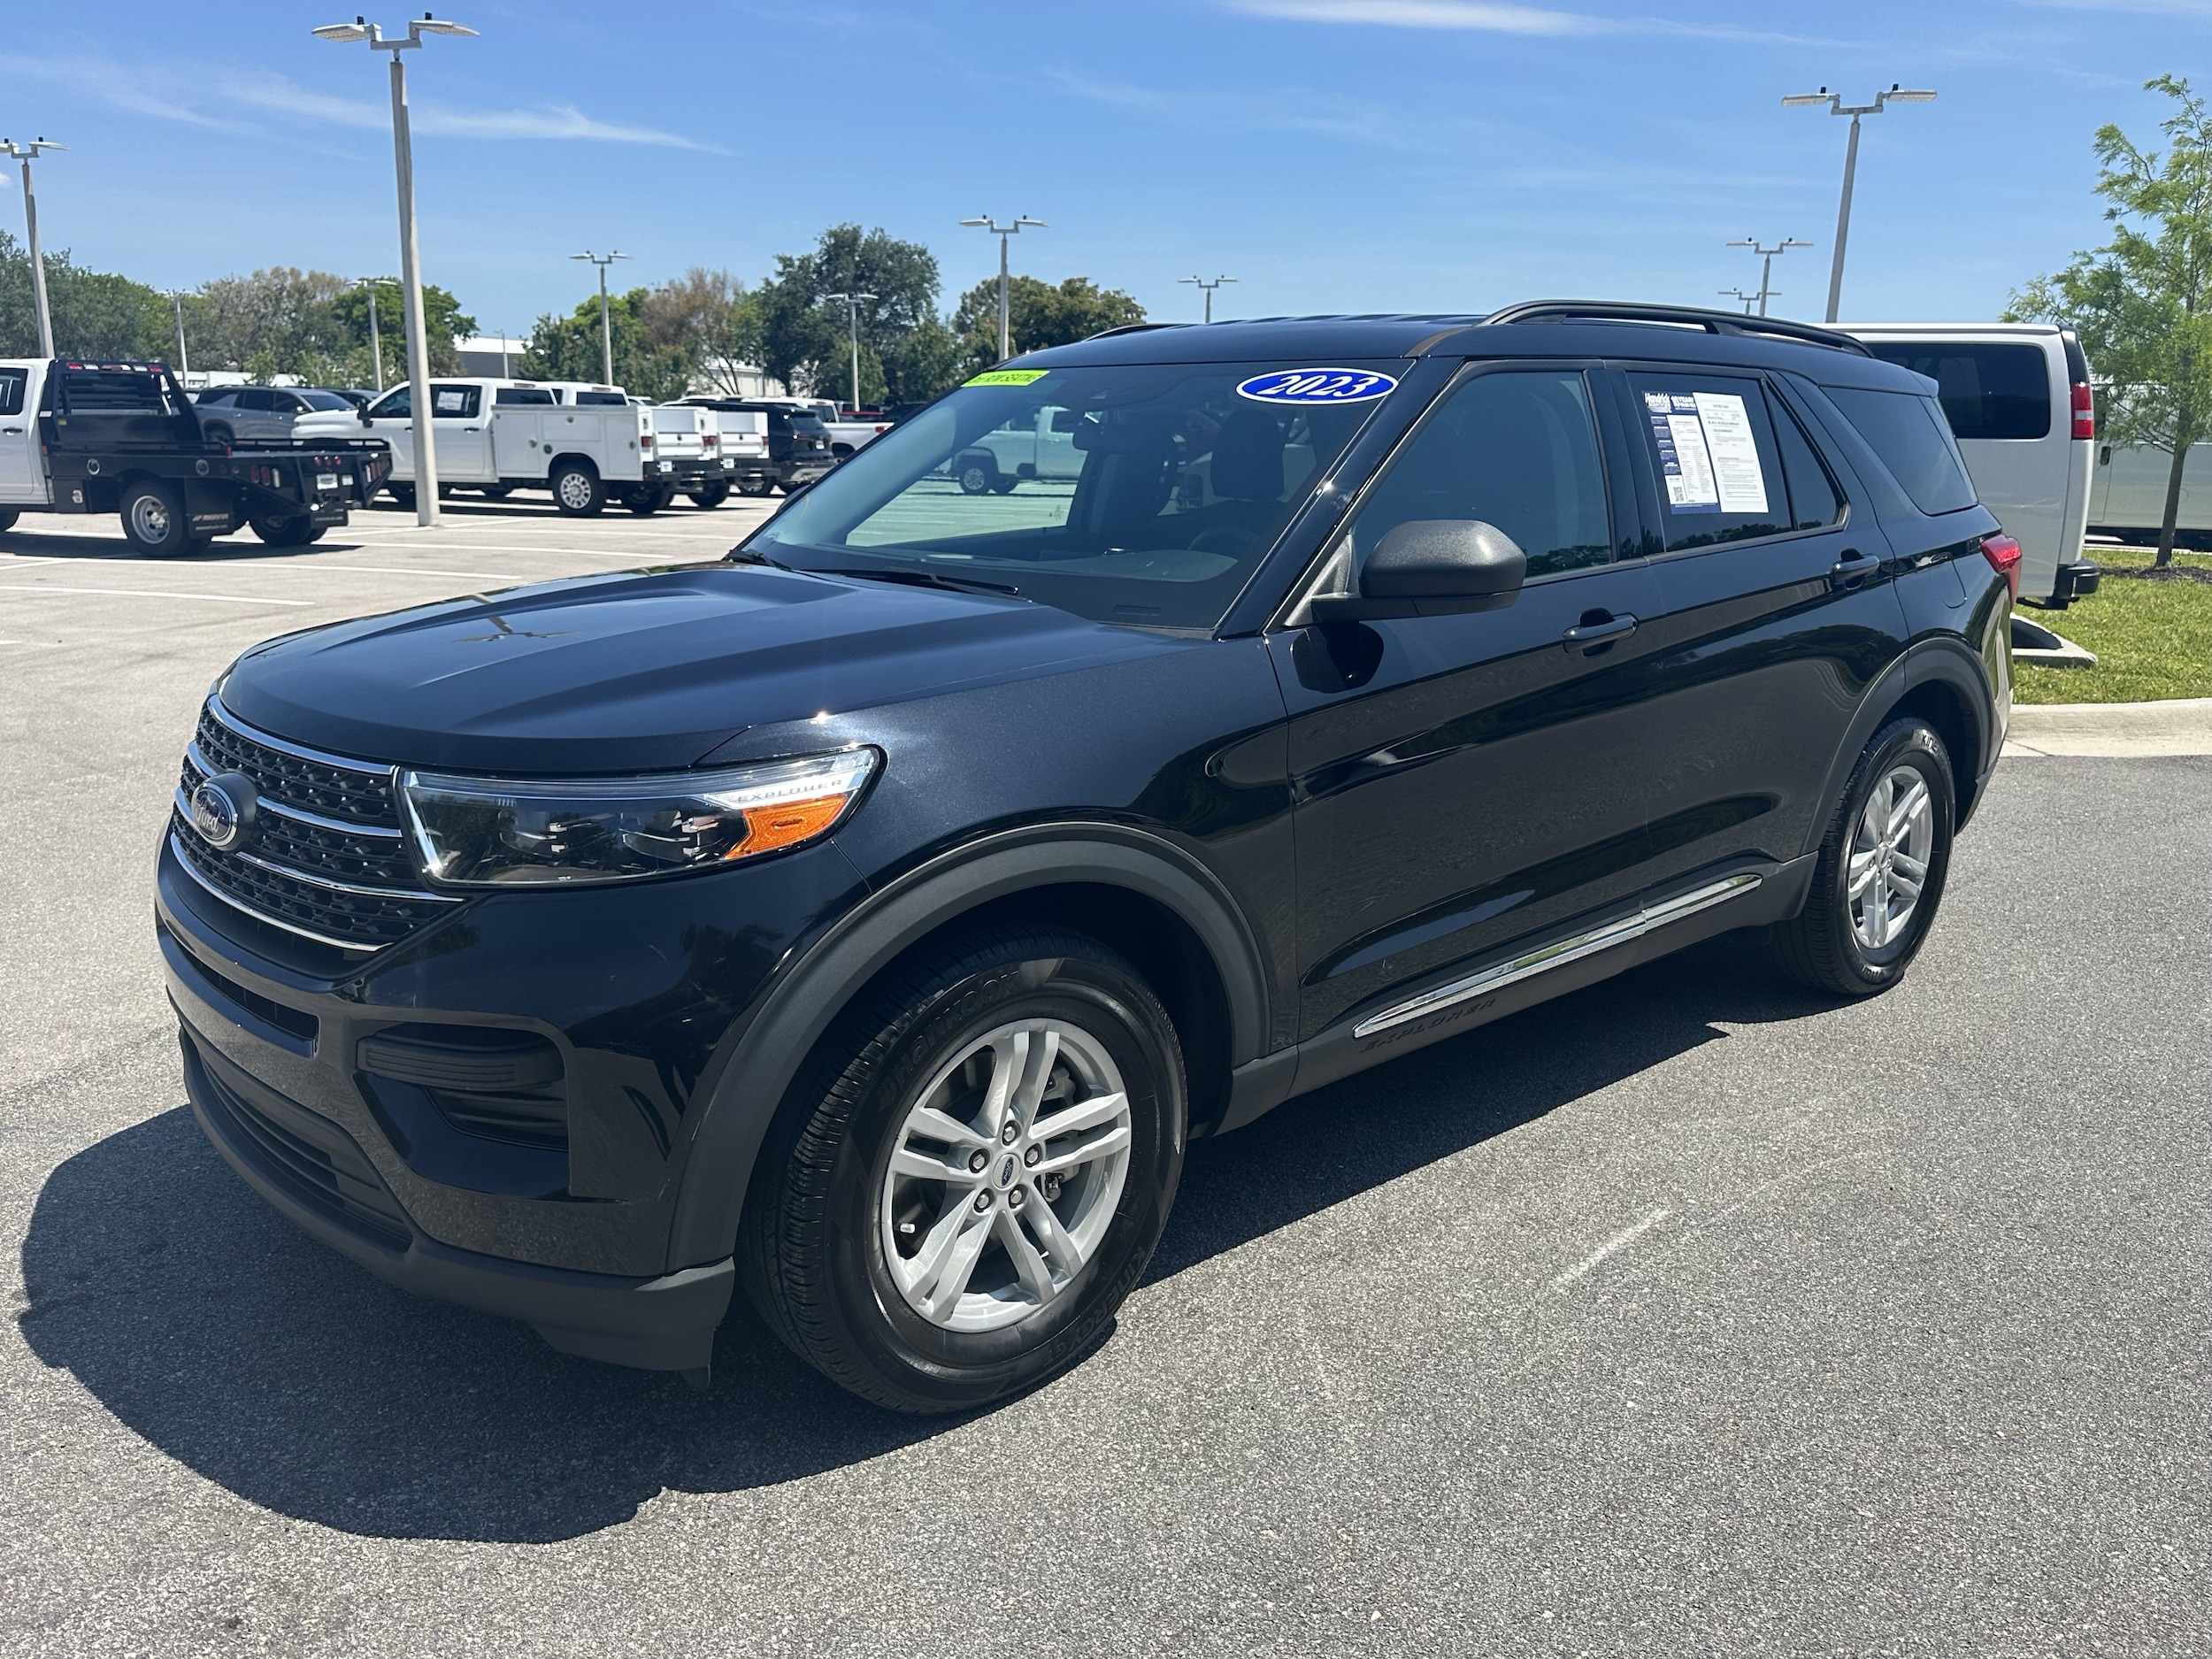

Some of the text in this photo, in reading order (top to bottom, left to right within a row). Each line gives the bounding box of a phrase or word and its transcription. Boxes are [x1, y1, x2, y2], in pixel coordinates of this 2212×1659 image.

[1256, 374, 1379, 397] 2023
[737, 780, 841, 803] EXPLORER
[195, 806, 221, 833] Ford
